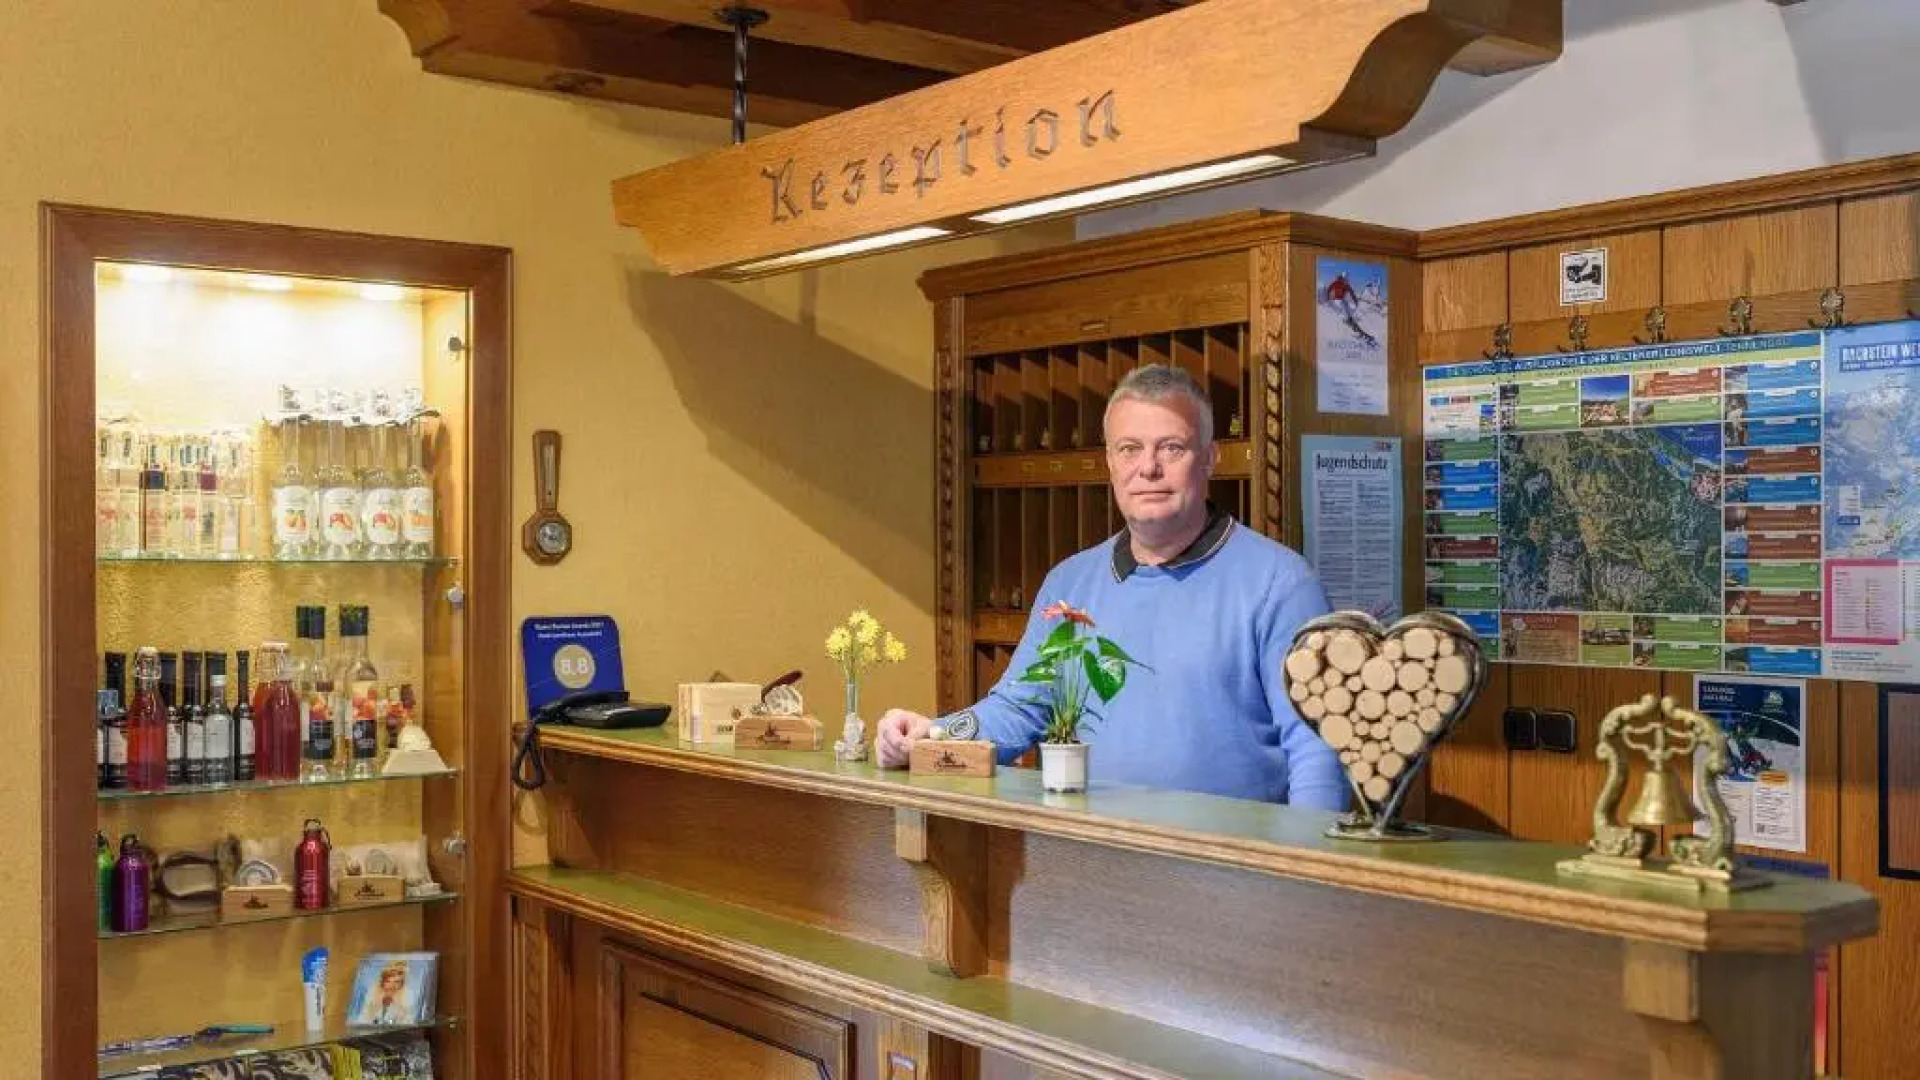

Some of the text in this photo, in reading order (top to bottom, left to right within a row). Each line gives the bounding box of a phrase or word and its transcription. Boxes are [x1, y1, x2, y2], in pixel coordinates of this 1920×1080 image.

[759, 89, 1122, 224] Rezeption
[1316, 453, 1389, 473] Jugendschutz
[560, 657, 588, 676] 8.8
